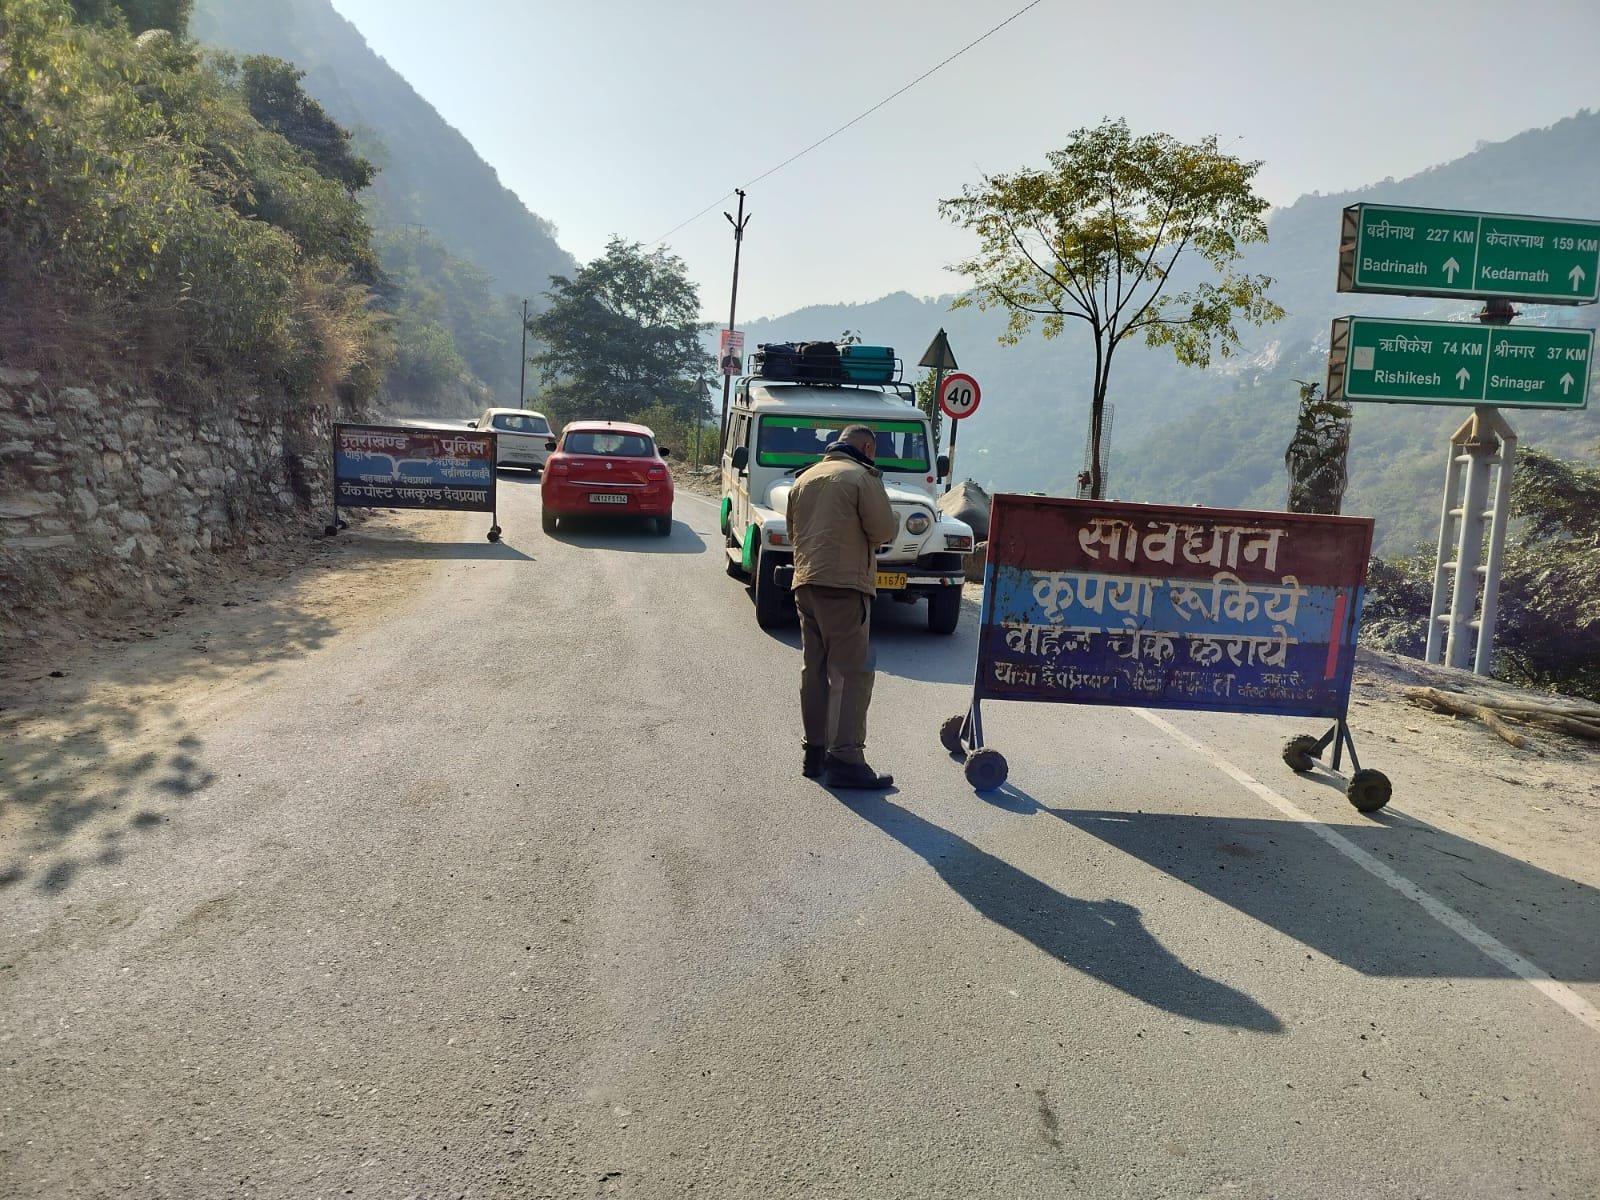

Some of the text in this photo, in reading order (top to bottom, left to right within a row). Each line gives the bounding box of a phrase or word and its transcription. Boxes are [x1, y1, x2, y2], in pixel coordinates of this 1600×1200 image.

[1367, 219, 1474, 244] बद्रीनाथ 227 KM
[1486, 229, 1598, 251] केदारनाथ 159 KM
[1363, 258, 1428, 275] Badrinath
[1481, 266, 1549, 283] Kedarnath
[1378, 334, 1482, 356] ऋषिकेश 74 KM
[1495, 339, 1586, 361] श्रीनगर 37 KM
[1374, 370, 1441, 386] Rishikesh
[1490, 375, 1546, 391] Srinagar
[947, 387, 972, 407] 40
[340, 433, 487, 457] उत्तराखण्ड पुलिस
[362, 484, 393, 498] पोस्ट
[395, 487, 442, 503] रामकुण्ड
[443, 486, 487, 502] देवप्रयाग
[1078, 518, 1288, 572] सावधान
[1031, 570, 1163, 622] कृपया
[1185, 624, 1298, 668] कराये
